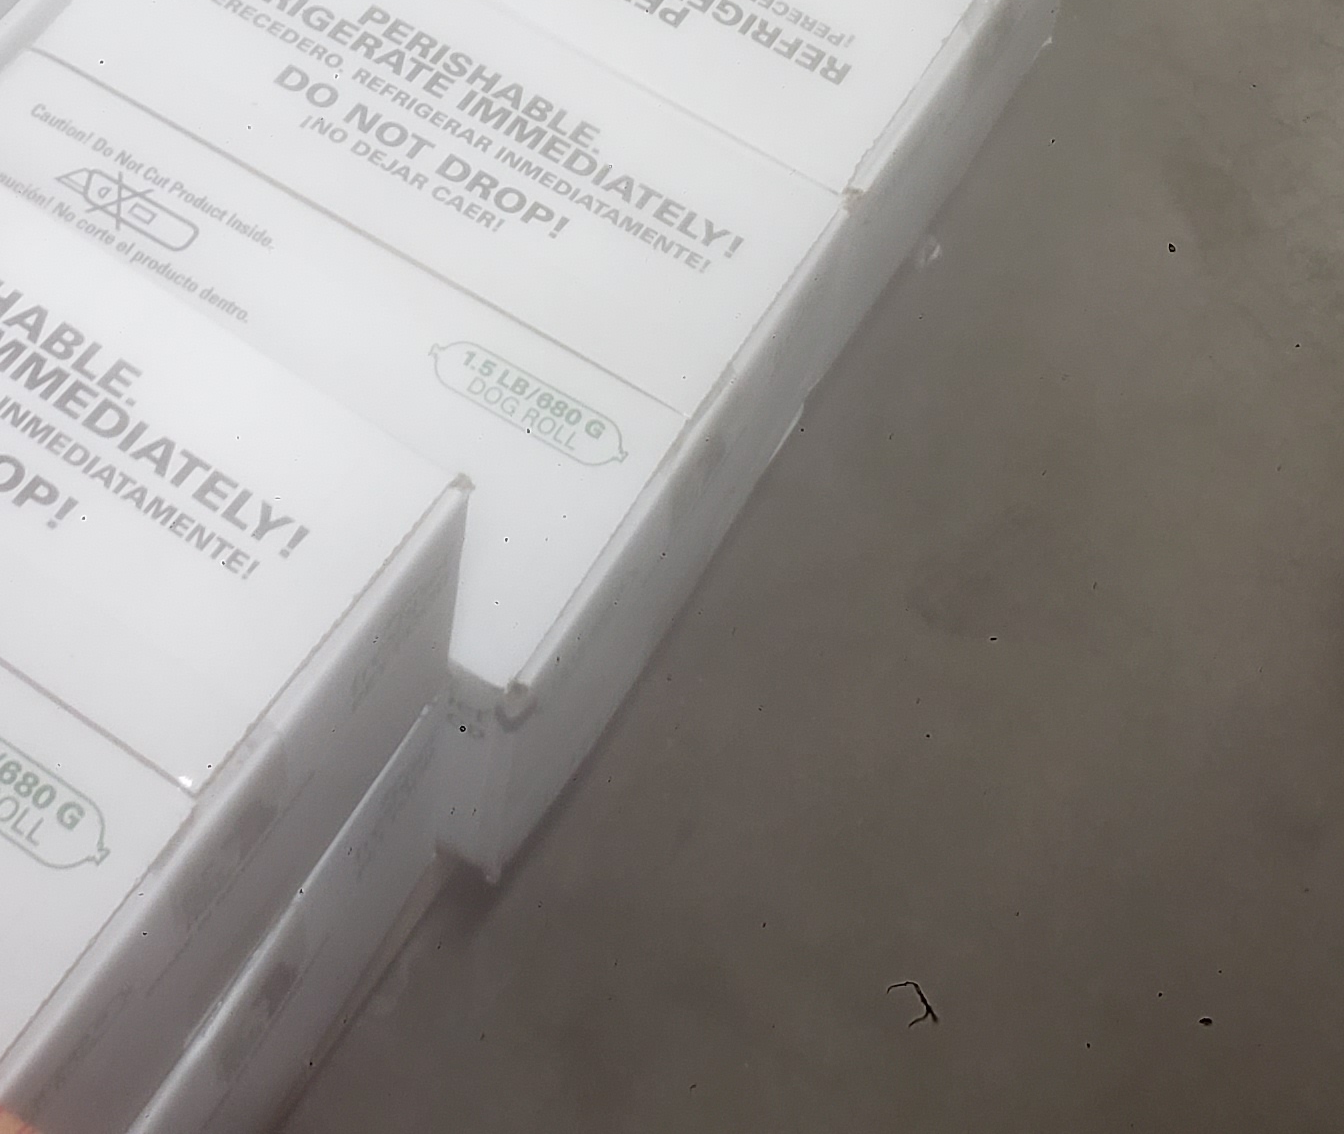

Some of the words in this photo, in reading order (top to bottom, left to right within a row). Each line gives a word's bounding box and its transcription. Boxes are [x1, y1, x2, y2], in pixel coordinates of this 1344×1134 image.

[29, 102, 95, 146] Caution!
[91, 136, 116, 159] Do
[113, 148, 146, 177] Not
[142, 165, 171, 190] Cut
[168, 180, 229, 223] Product
[272, 62, 341, 110] DO
[342, 102, 437, 156] NOT
[432, 152, 573, 241] DROP!
[298, 113, 351, 145] ¡NO
[351, 138, 431, 192] DEJAR
[430, 183, 507, 235] CAER!
[350, 67, 491, 155] REFRIGERAR
[494, 143, 713, 276] INMEDIATAMENTE!
[455, 82, 745, 261] IMMEDIATELY!
[52, 200, 78, 225] No
[75, 217, 116, 247] corte
[129, 244, 199, 295] producto
[198, 279, 251, 324] dentro.
[462, 349, 498, 378] 1.5
[496, 368, 583, 427] LB/680
[584, 418, 607, 441] G
[465, 376, 521, 418] DOG
[520, 407, 577, 452] ROLL
[56, 799, 87, 832] G
